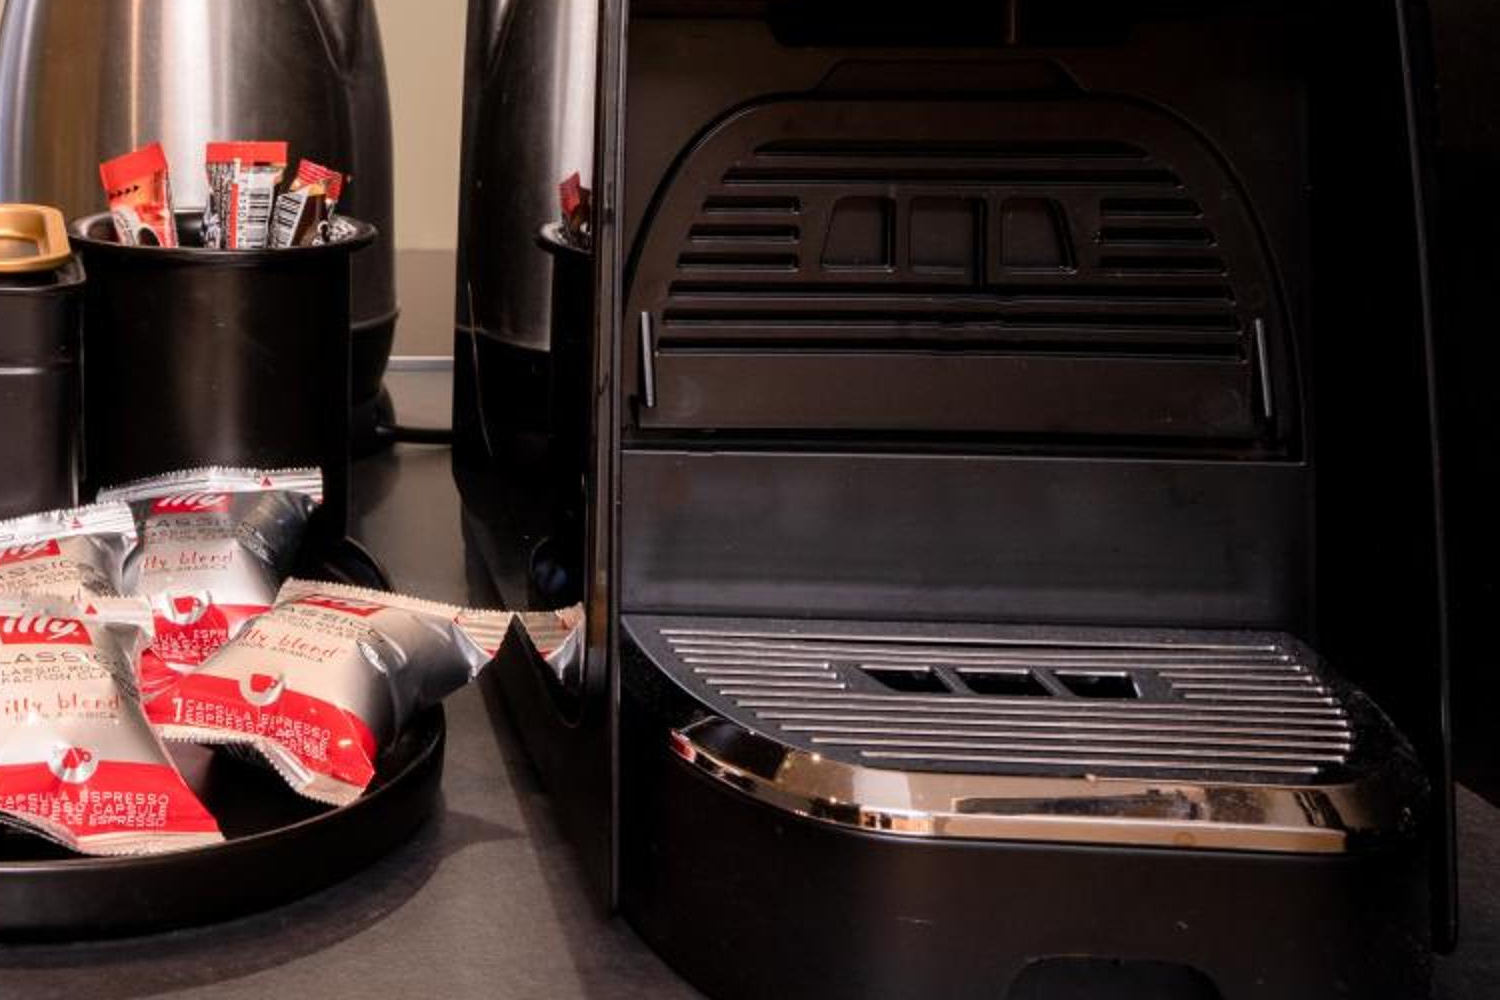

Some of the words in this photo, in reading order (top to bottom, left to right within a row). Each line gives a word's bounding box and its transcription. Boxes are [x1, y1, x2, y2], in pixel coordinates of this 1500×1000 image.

[3, 615, 78, 640] illy
[56, 693, 120, 711] blend
[172, 697, 183, 723] 1
[78, 788, 169, 806] ESPRESSO
